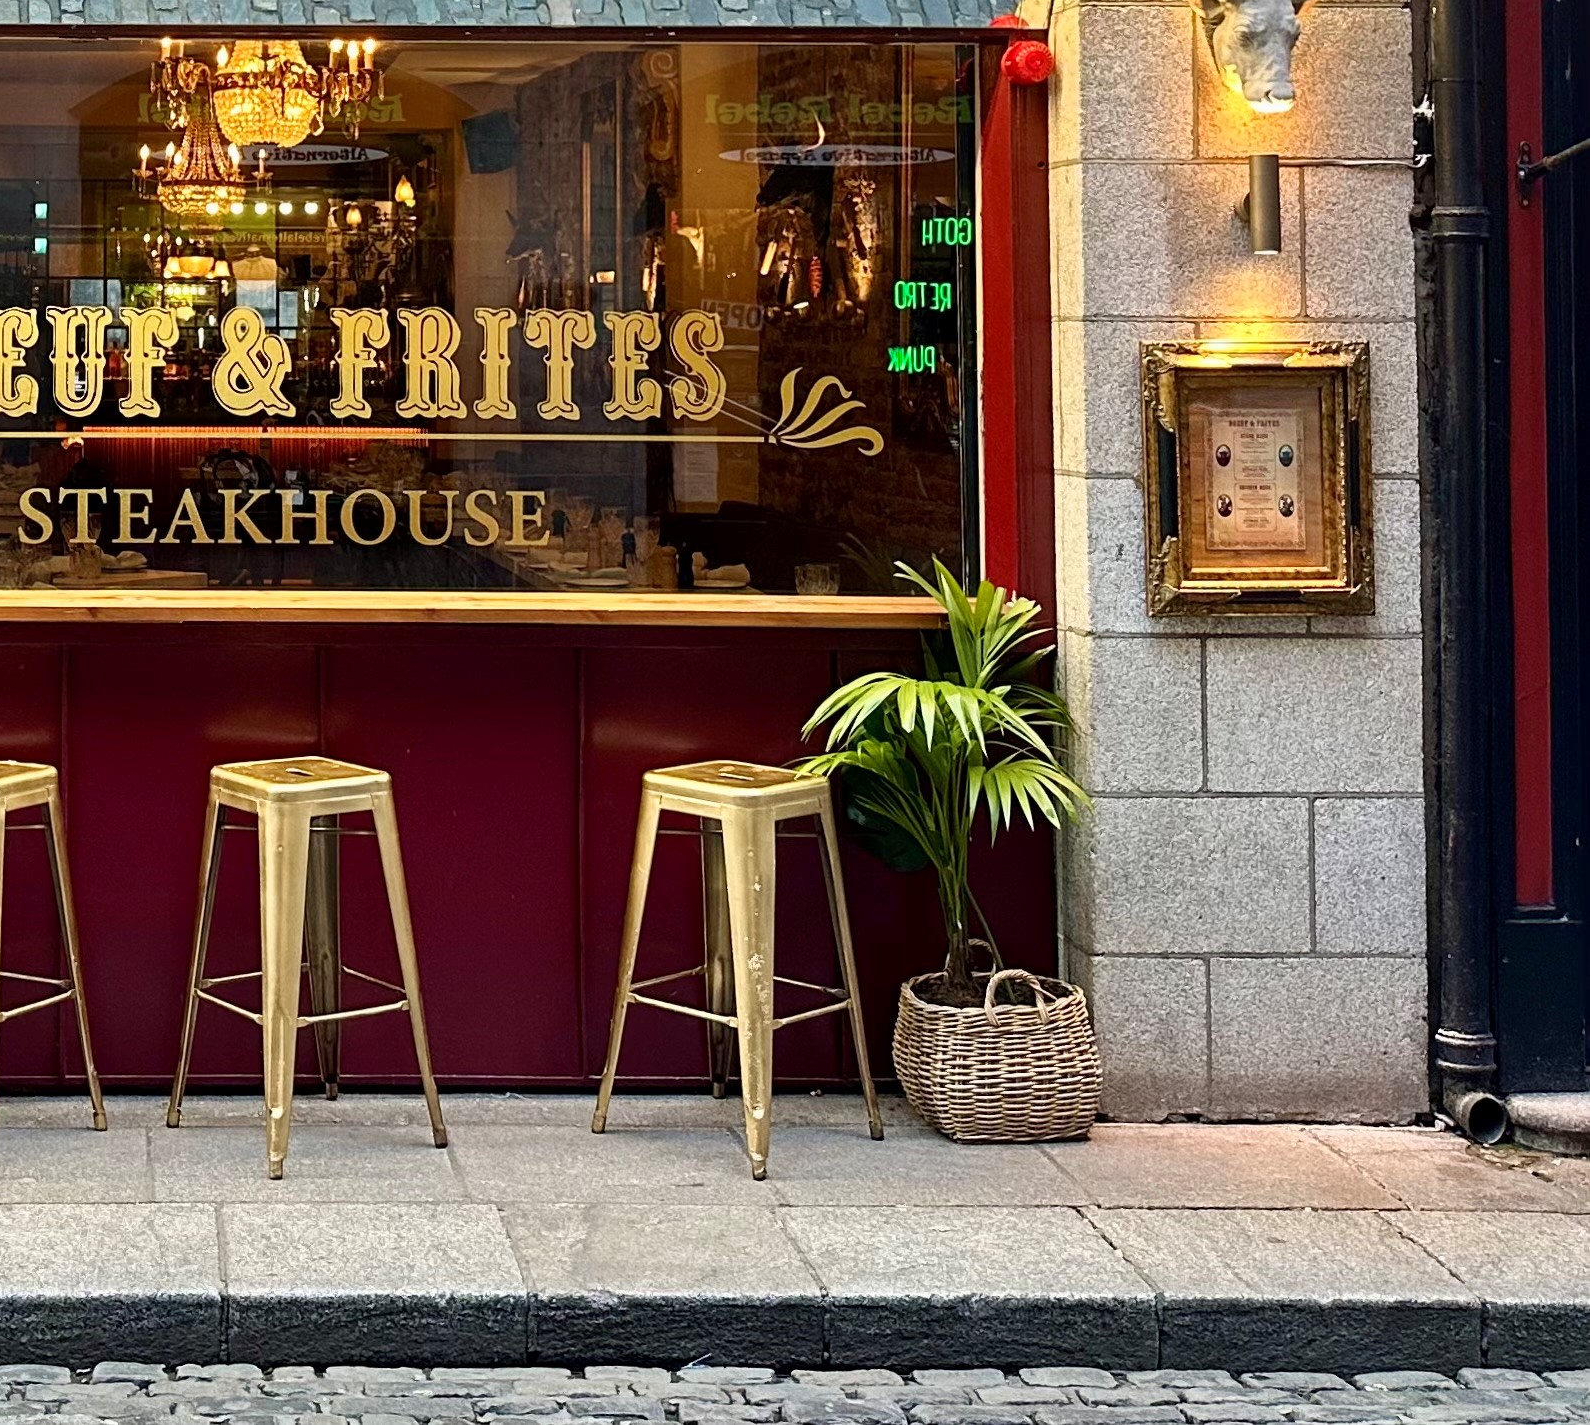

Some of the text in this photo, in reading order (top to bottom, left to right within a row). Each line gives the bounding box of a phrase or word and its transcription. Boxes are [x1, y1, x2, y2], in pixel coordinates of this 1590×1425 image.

[210, 307, 297, 419] &
[330, 307, 727, 423] FRITES
[16, 485, 552, 548] STEAKHOUSE
